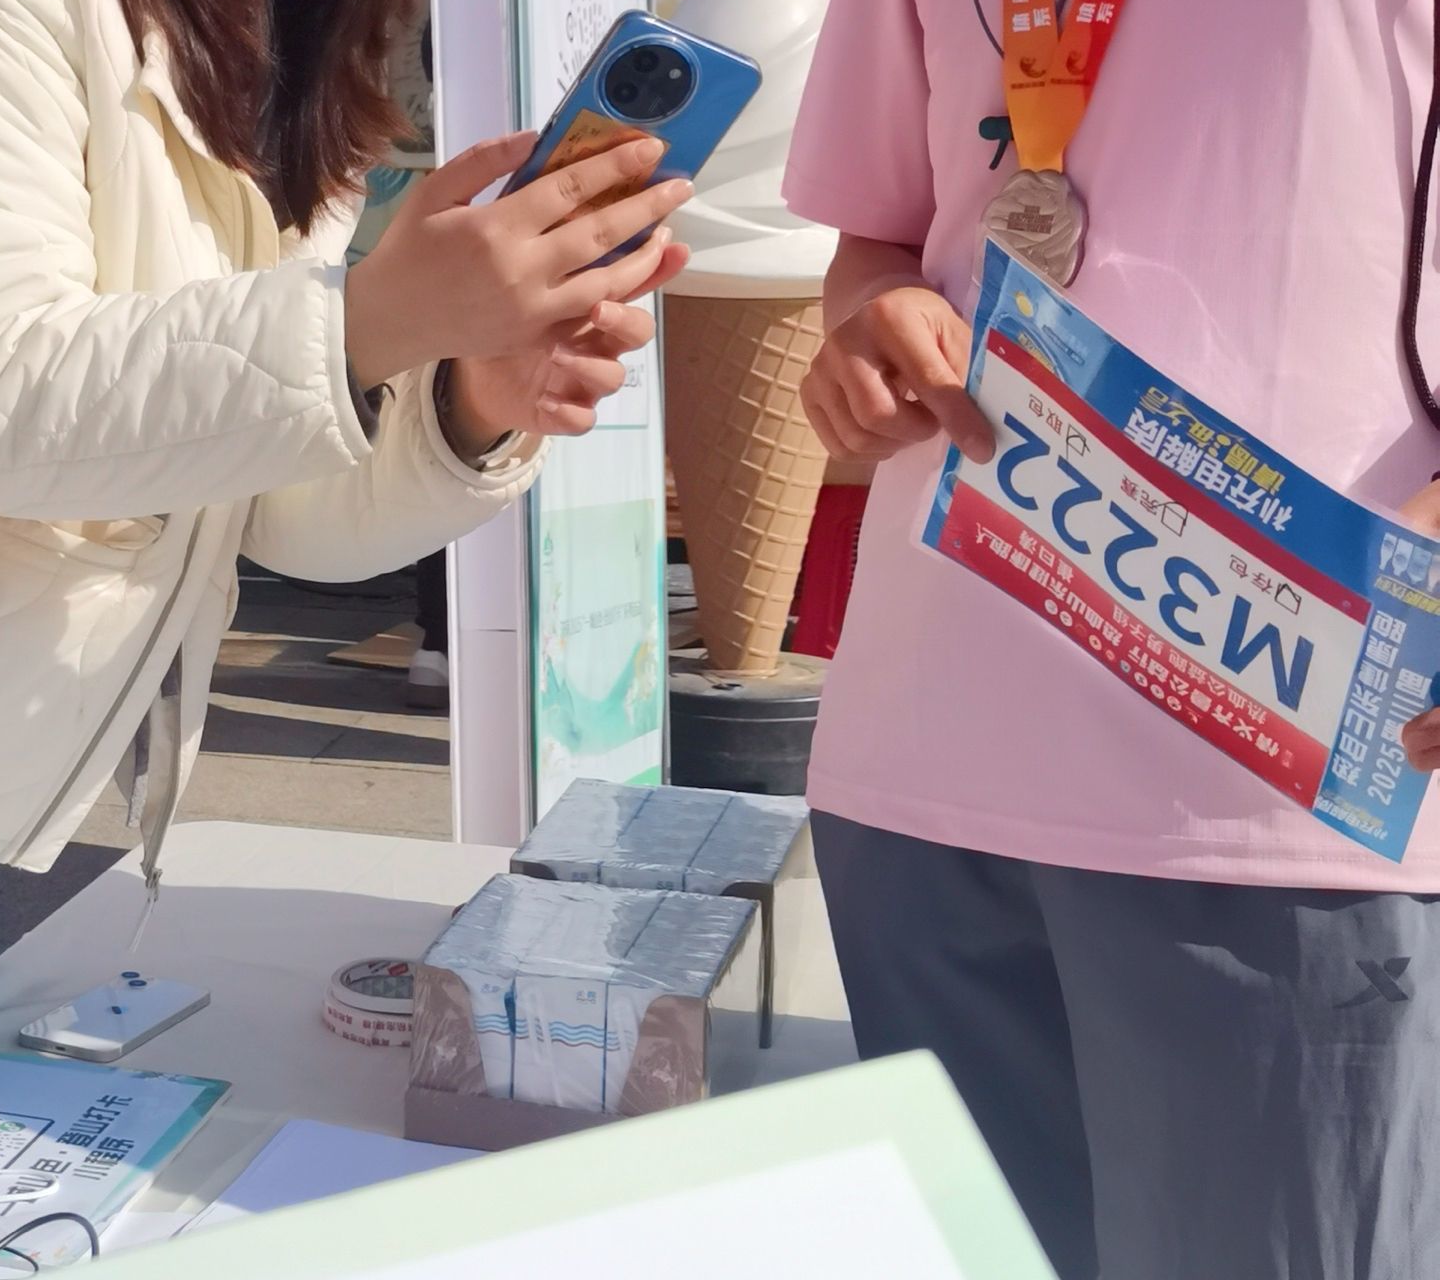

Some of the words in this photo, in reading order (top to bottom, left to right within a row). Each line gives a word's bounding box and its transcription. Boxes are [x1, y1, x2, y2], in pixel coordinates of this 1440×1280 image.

[1020, 392, 1067, 435] 取包
[1117, 407, 1295, 533] 补充电解质
[985, 533, 1126, 647] 热血山东健康跑
[1000, 410, 1315, 711] M3222
[1223, 553, 1277, 595] 存包
[1126, 642, 1282, 758] 情义齐鲁公益行
[1333, 610, 1407, 788] 热血山东健康跑
[73, 1136, 136, 1181] 小程序
